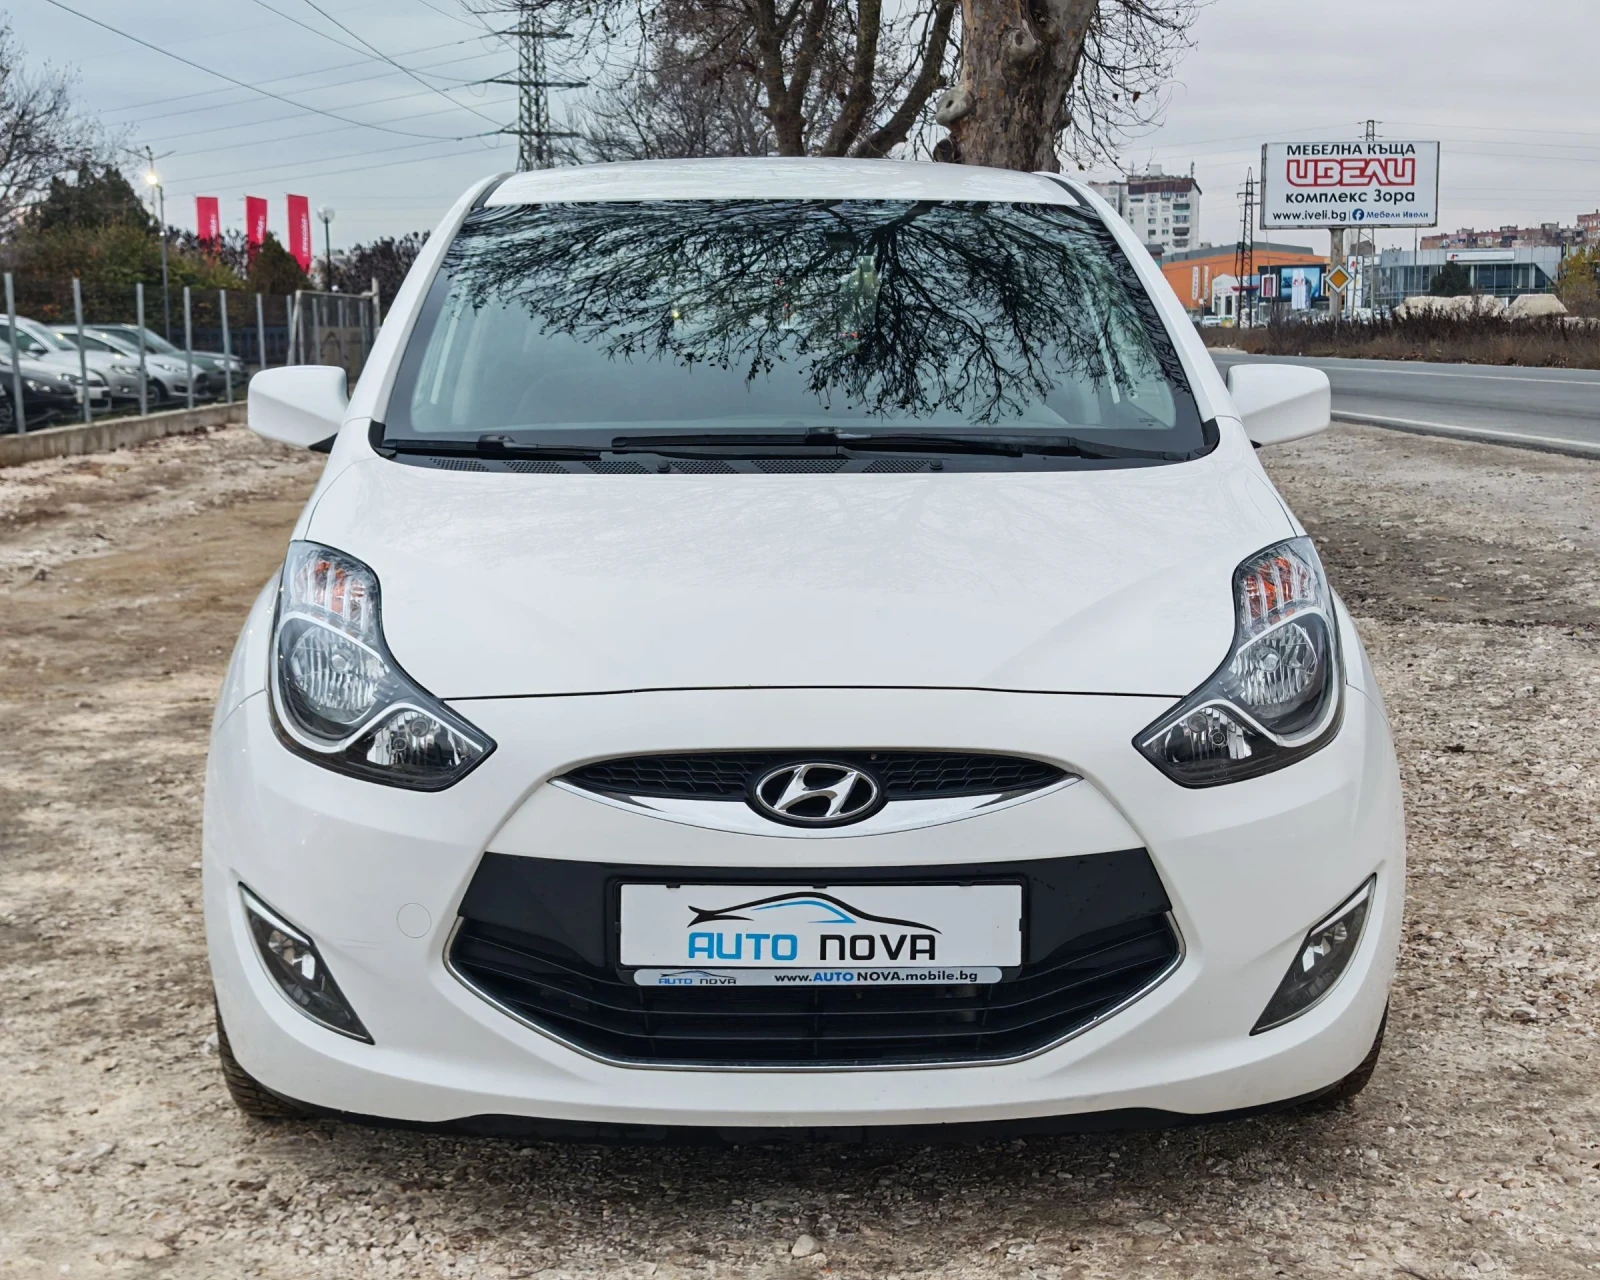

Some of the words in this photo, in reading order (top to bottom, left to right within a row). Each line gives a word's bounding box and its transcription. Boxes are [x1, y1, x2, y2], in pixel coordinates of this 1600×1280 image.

[1287, 144, 1361, 156] МЕБЕЛНА
[1368, 143, 1416, 157] КЪЩА
[1286, 159, 1415, 187] ИВЕЛИ
[1374, 189, 1415, 205] Зора
[1273, 210, 1346, 221] www.iveli.bg
[1366, 210, 1400, 219] Мебели
[688, 932, 797, 960] AUTO
[819, 934, 936, 961] NOVA
